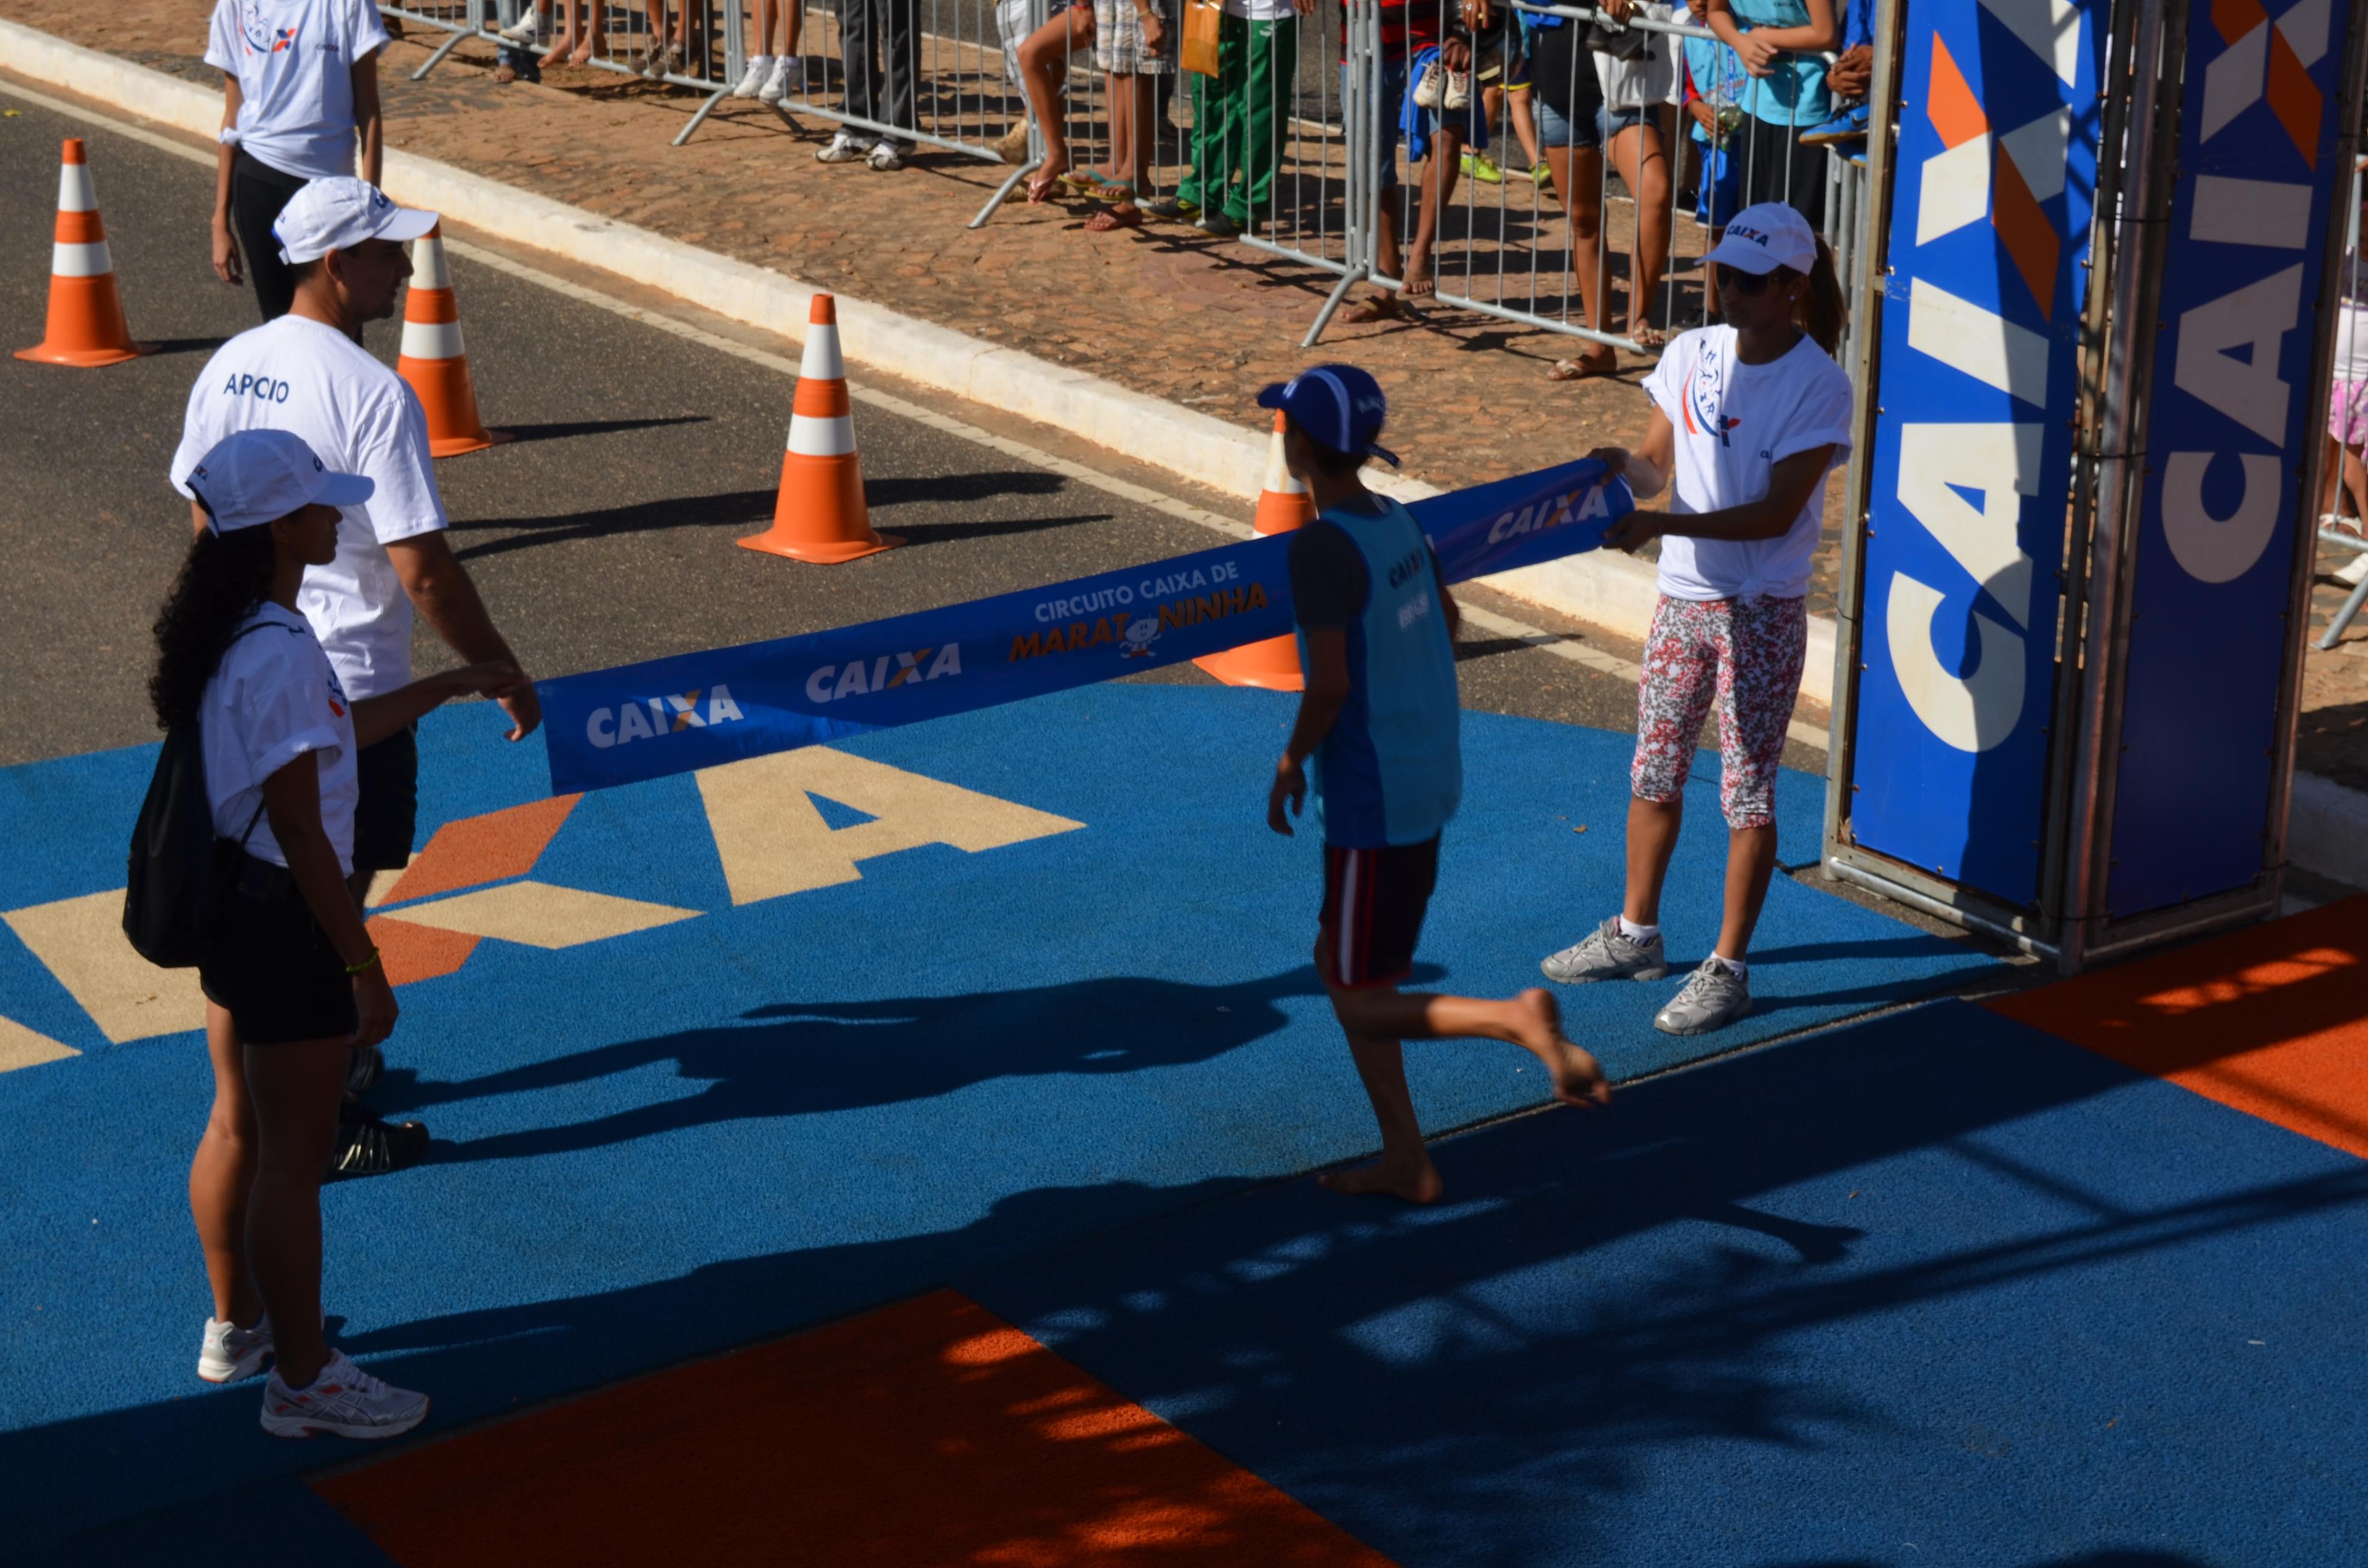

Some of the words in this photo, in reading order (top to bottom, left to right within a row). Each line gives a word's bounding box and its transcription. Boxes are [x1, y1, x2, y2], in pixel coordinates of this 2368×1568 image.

[1726, 225, 1769, 247] CAIXA
[1488, 485, 1610, 544] CAIXA
[1034, 586, 1134, 623] CIRCUITO
[1139, 569, 1207, 599] CAIXA
[1210, 561, 1239, 584] DE
[805, 643, 962, 703] CAIXA
[586, 683, 744, 748] CAIXA
